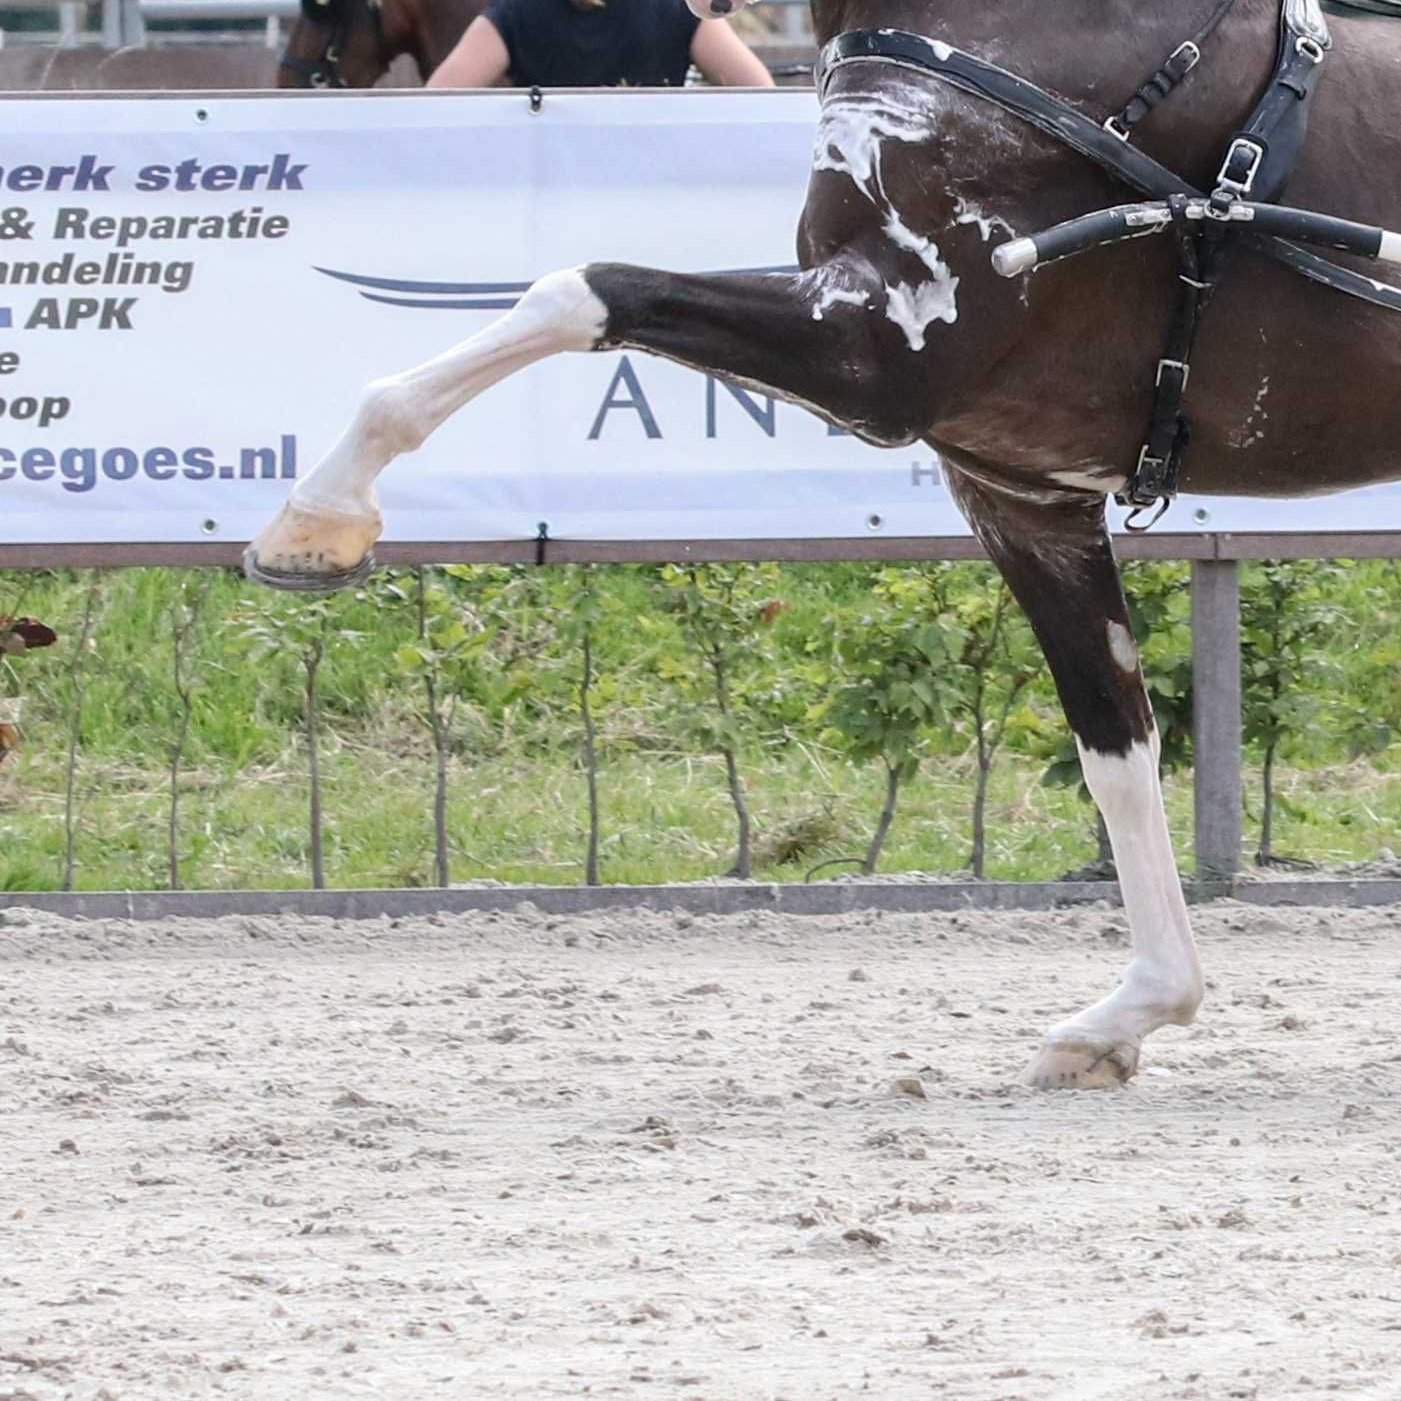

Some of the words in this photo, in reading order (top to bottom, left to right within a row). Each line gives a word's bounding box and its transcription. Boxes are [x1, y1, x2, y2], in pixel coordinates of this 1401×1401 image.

[0, 154, 116, 192] erk
[134, 153, 310, 192] sterk
[0, 206, 35, 240] &
[53, 206, 290, 248] Reparatie
[23, 297, 138, 330] APK
[0, 396, 71, 428] oop
[587, 354, 852, 440] AN
